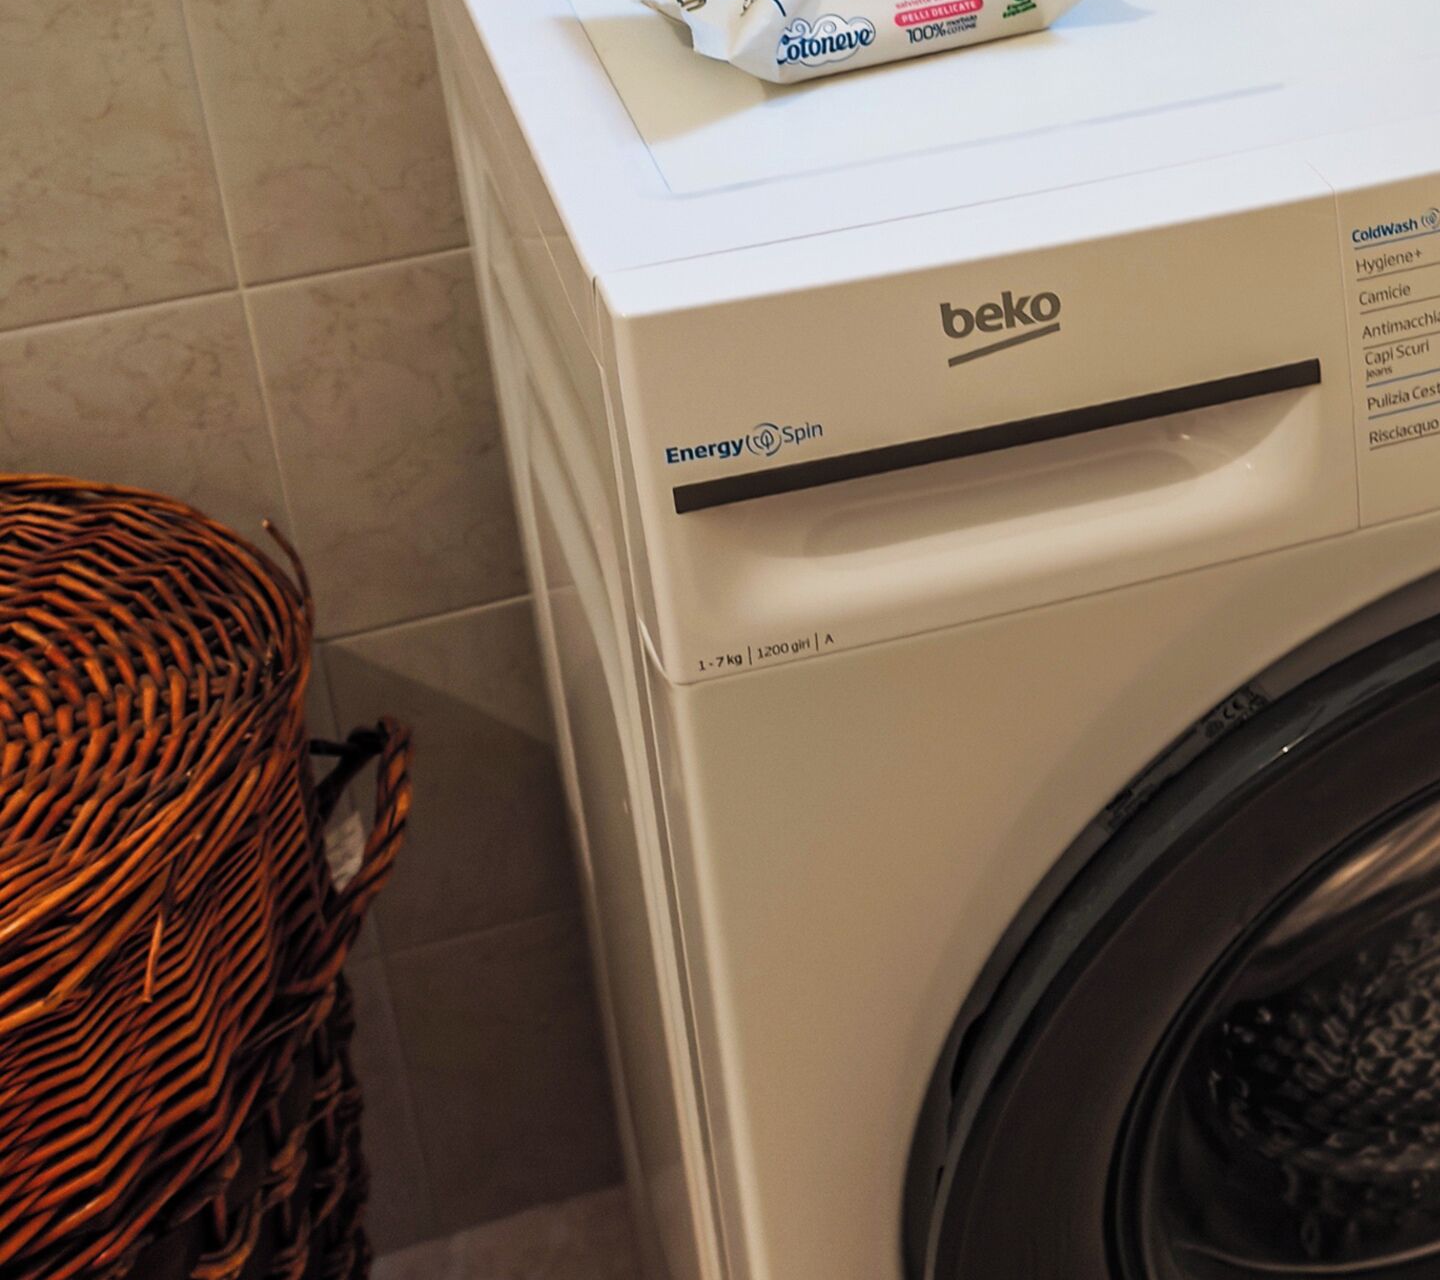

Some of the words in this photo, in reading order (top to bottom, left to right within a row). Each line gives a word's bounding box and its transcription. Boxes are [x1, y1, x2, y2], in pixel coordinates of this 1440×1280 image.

[901, 8, 931, 24] PELLI
[931, 0, 977, 18] DELICATE
[906, 20, 948, 45] 100%
[1351, 217, 1419, 244] ColdWash
[1355, 248, 1423, 275] Hygiene+
[1358, 283, 1412, 306] Camicie
[938, 290, 1062, 340] beko
[1364, 343, 1394, 366] Capi
[1395, 339, 1431, 359] Scuri
[1364, 365, 1393, 382] Jeans
[1366, 391, 1411, 411] Pulizia
[665, 437, 744, 465] Energy
[782, 421, 824, 446] Spin
[1368, 417, 1440, 445] Risciacquo
[716, 656, 725, 669] 7
[726, 653, 743, 667] kg
[757, 642, 790, 660] 1200
[791, 636, 812, 654] giri
[824, 633, 835, 645] A
